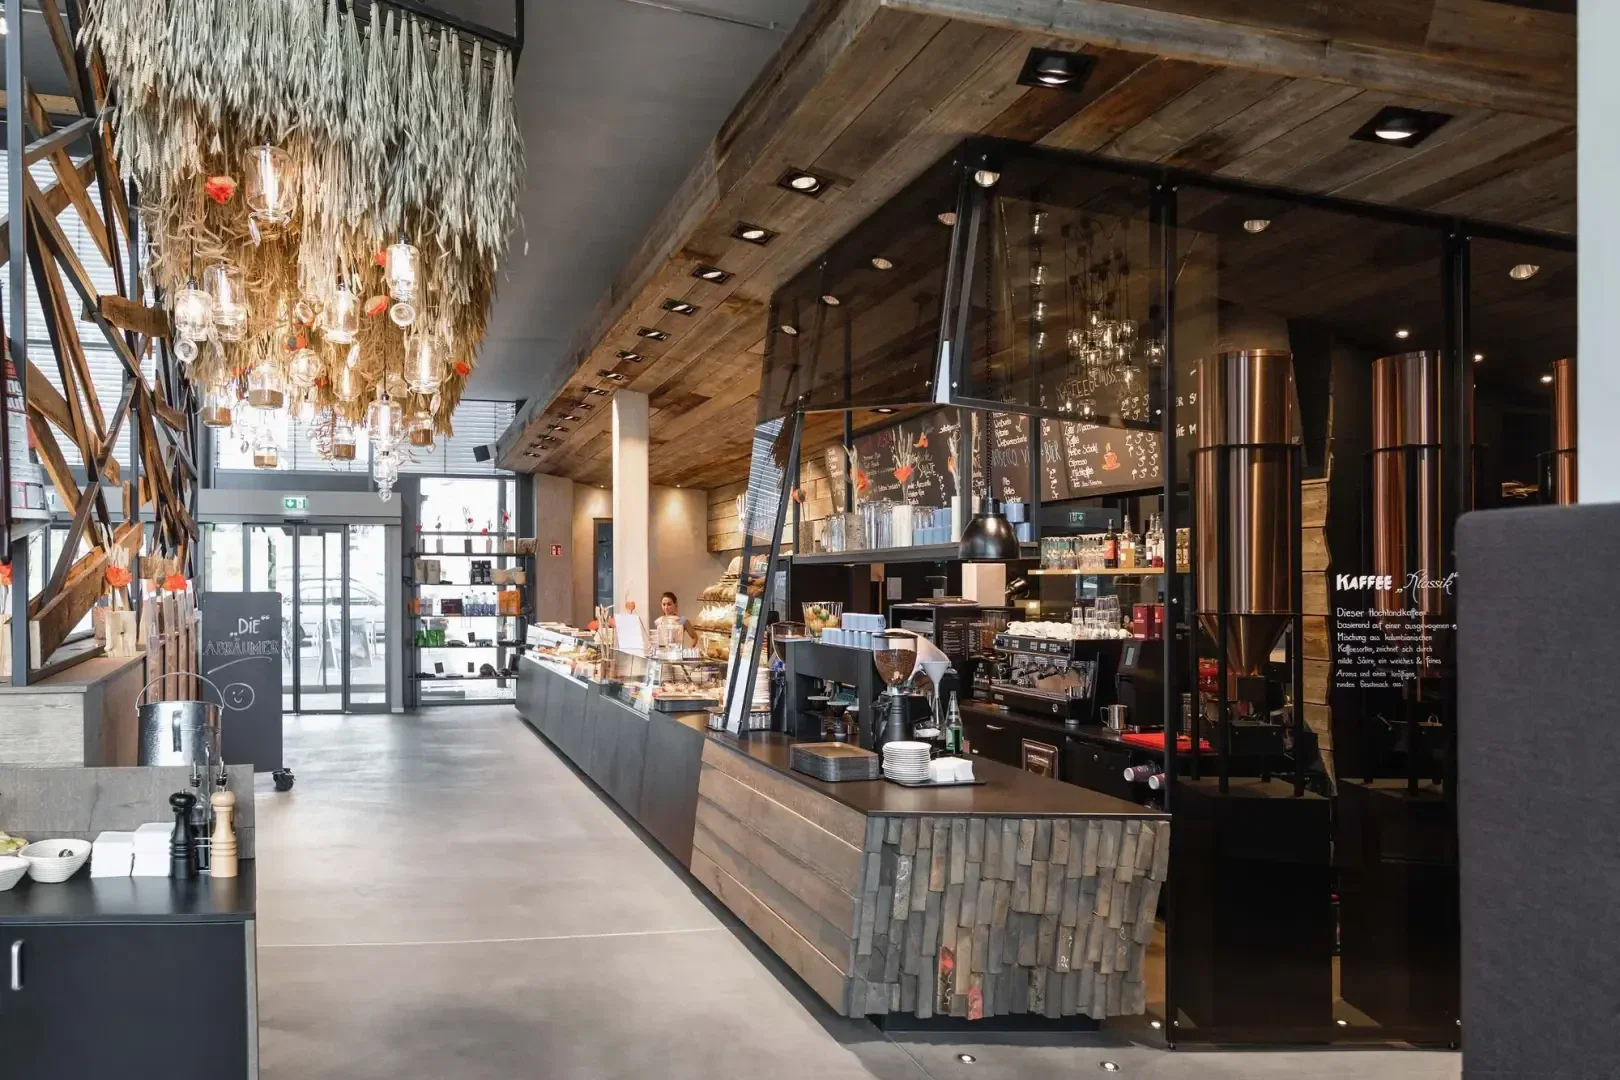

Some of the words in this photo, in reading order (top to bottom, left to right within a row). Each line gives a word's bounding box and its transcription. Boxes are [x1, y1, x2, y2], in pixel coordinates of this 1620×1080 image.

[1336, 574, 1392, 591] KAFFEE
[1337, 607, 1365, 618] Dieser
[1337, 620, 1370, 629] basierend
[1372, 621, 1383, 631] auf
[1337, 632, 1366, 643] Mischung
[1416, 657, 1423, 665] &
[1336, 669, 1357, 677] Aroma
[1360, 669, 1370, 677] und
